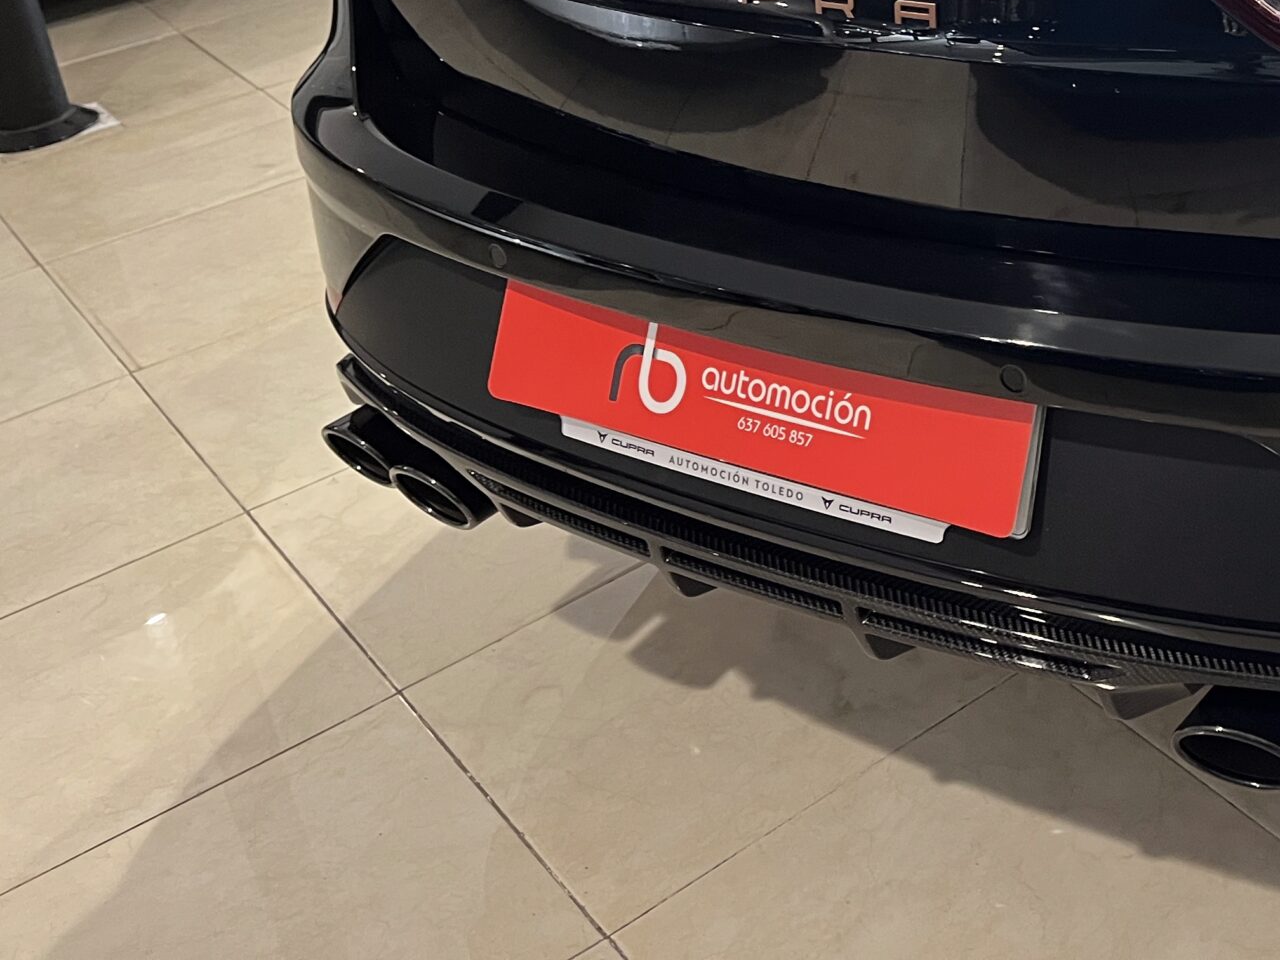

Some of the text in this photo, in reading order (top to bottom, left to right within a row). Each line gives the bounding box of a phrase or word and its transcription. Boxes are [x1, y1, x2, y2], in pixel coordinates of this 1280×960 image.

[701, 366, 872, 431] automoción
[737, 416, 813, 448] 637 605 857
[610, 437, 893, 525] CUPRA AUTOMOCIÓN TOLEDO CUPRA
